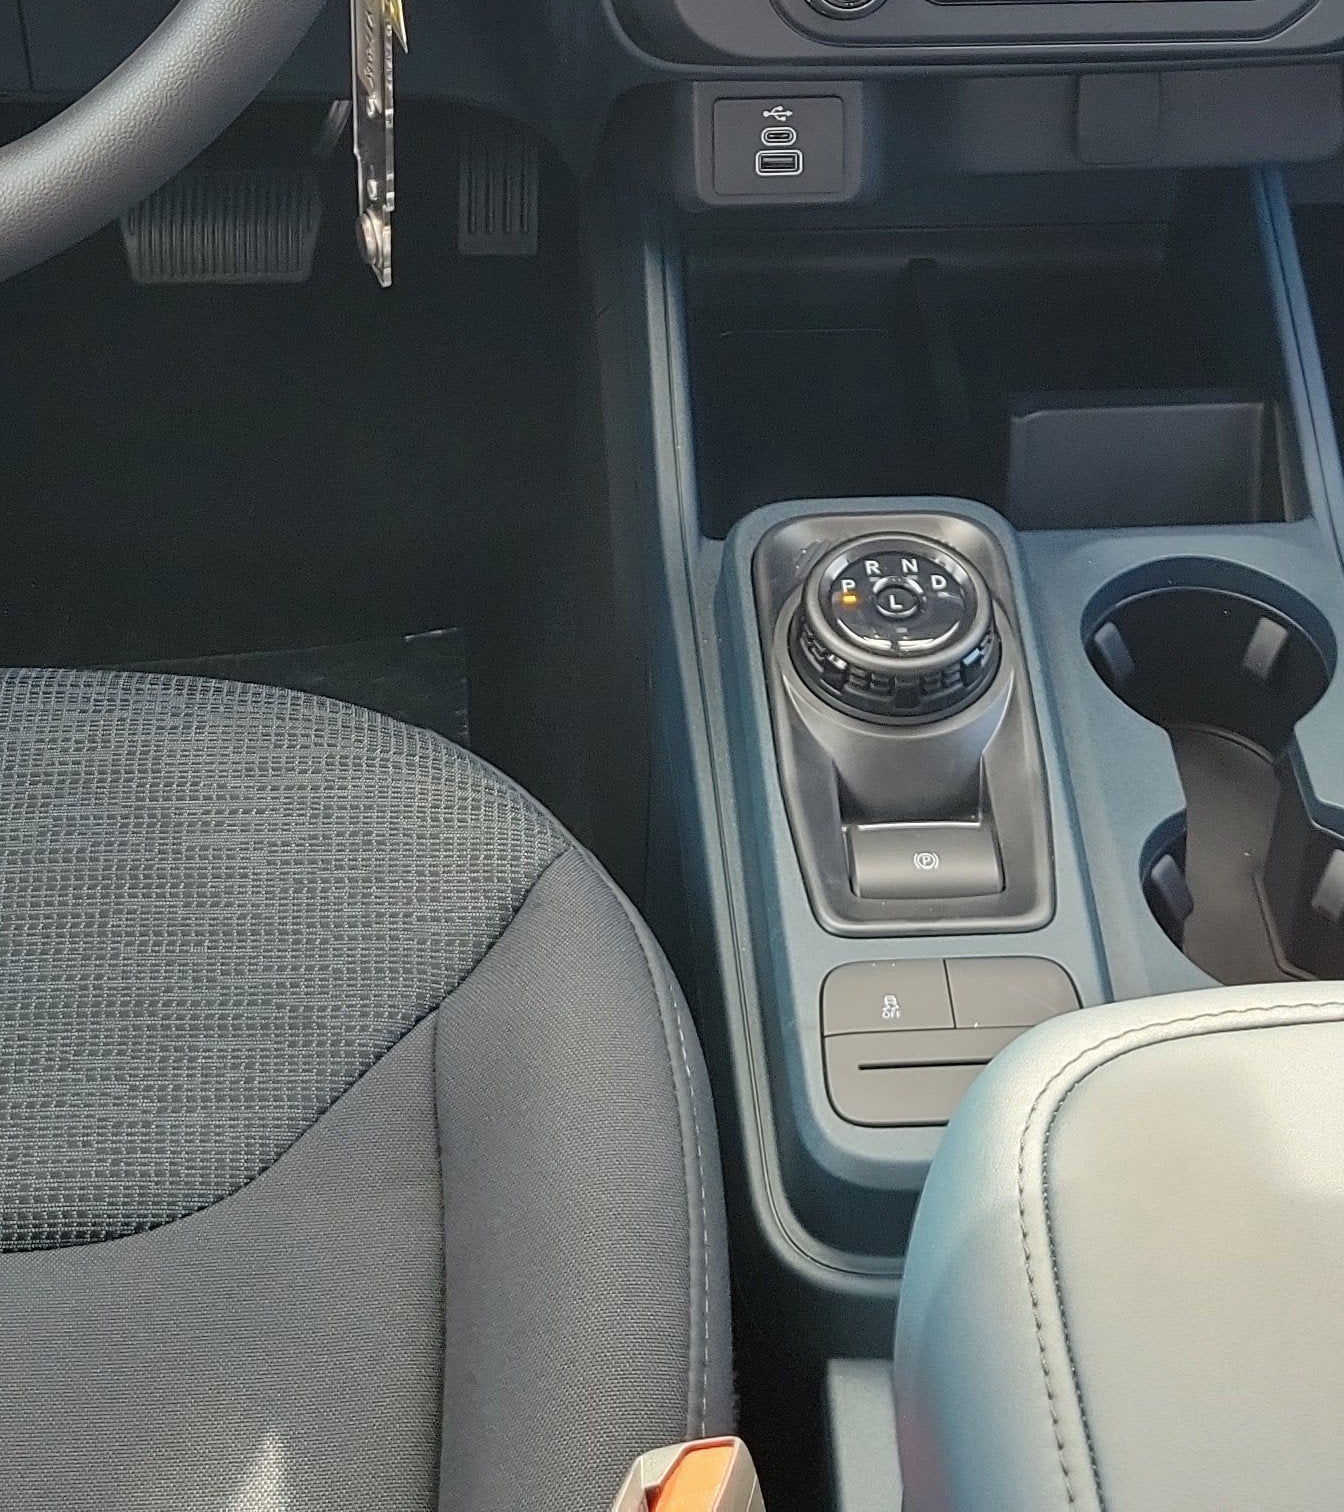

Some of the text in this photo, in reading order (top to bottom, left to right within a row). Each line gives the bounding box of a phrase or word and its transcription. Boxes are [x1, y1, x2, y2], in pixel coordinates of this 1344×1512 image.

[841, 558, 947, 593] P R N D
[889, 594, 903, 609] L
[882, 1010, 902, 1019] OFF
